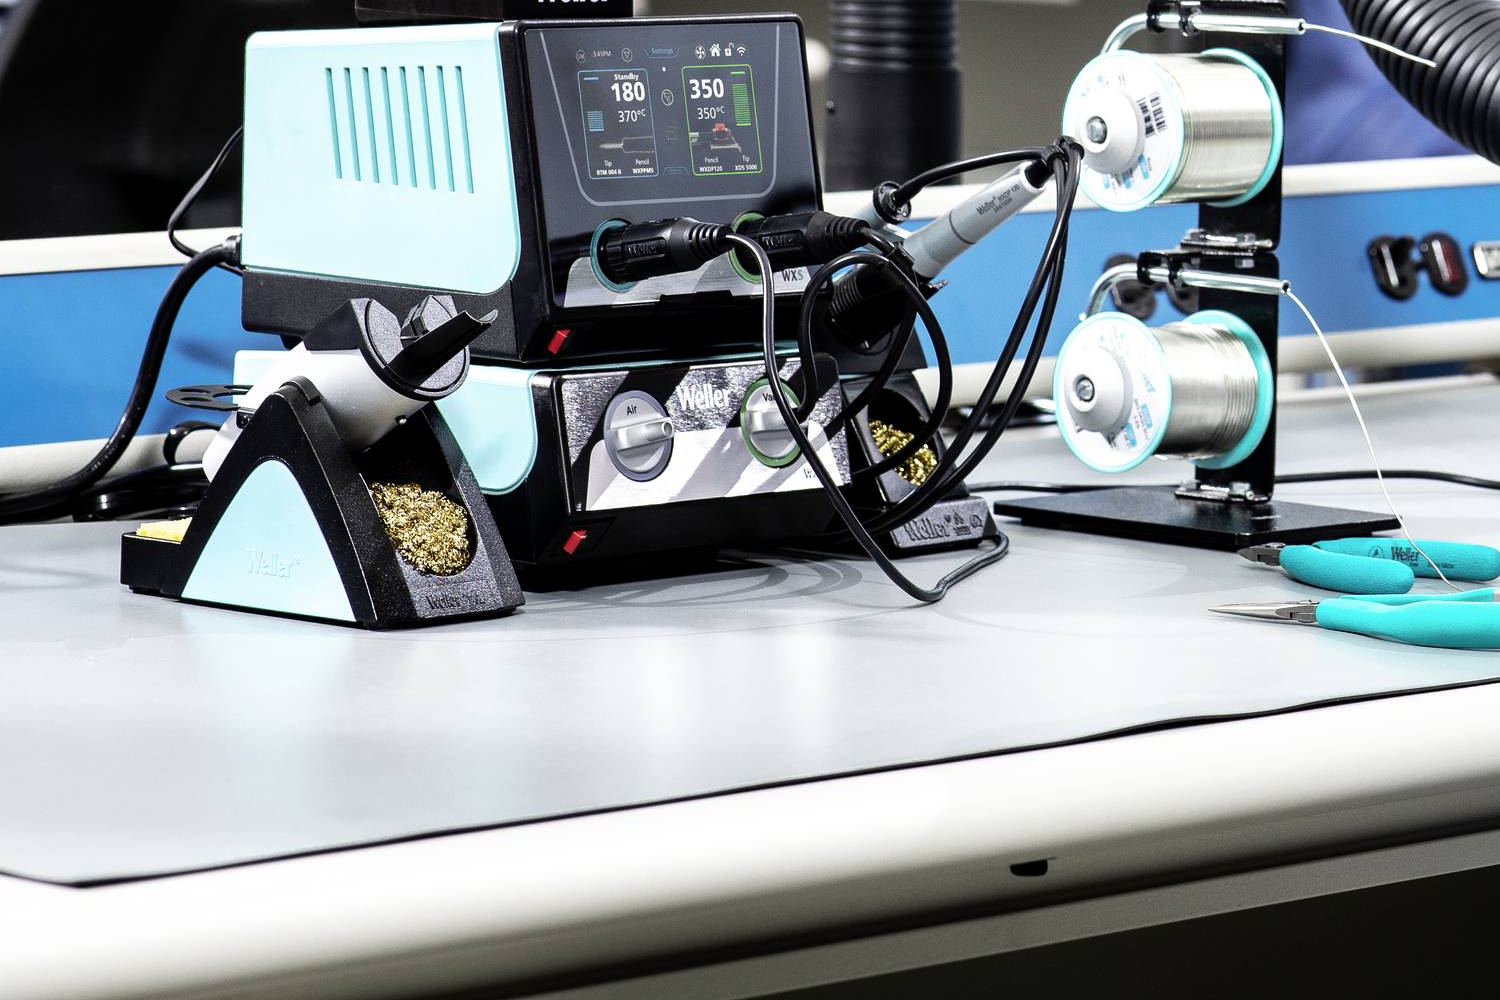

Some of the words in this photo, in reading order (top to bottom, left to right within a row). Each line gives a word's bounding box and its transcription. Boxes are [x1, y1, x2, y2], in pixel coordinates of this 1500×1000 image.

[613, 72, 640, 82] Standby
[610, 81, 646, 102] 180
[689, 78, 725, 99] 350
[603, 160, 613, 168] Tip
[704, 156, 719, 164] Pencil
[781, 269, 804, 282] WXS
[675, 383, 730, 411] Weller
[762, 392, 775, 402] Va
[626, 404, 638, 417] Air
[1391, 546, 1419, 562] Weller
